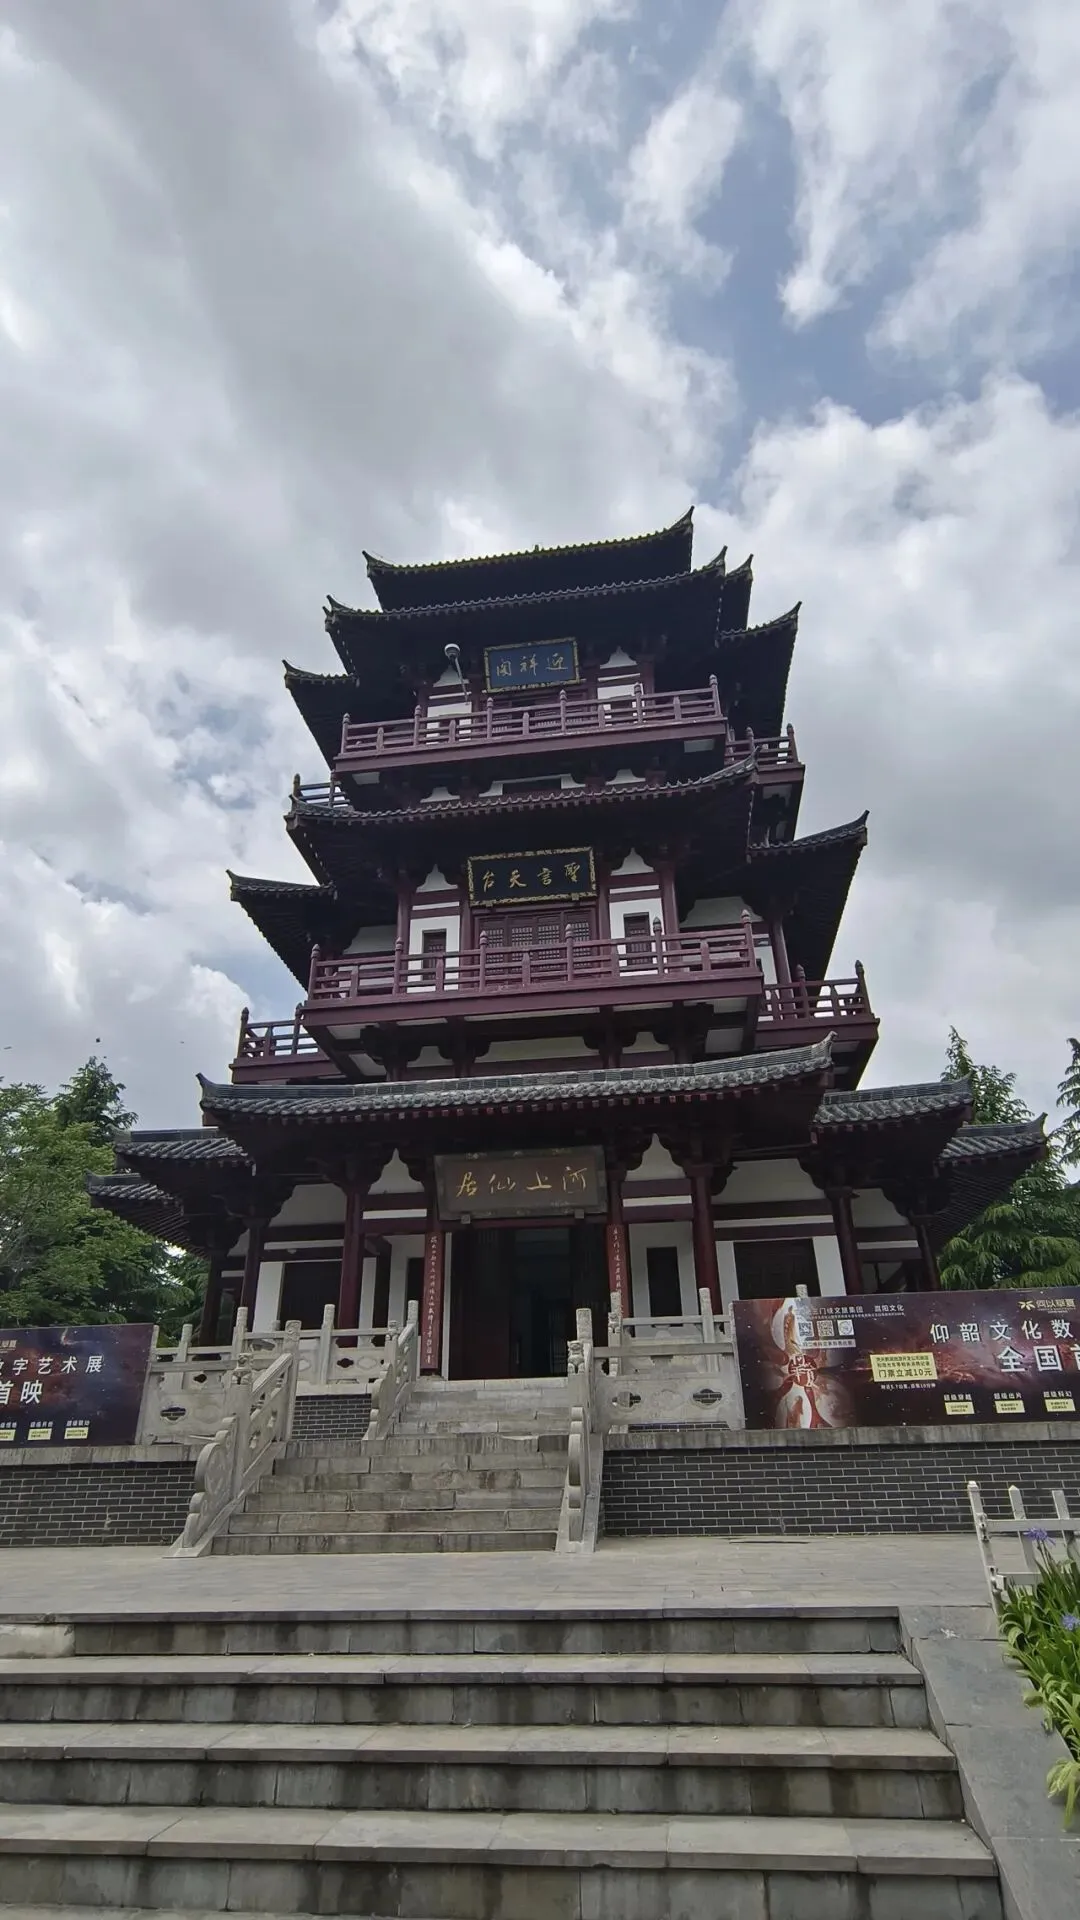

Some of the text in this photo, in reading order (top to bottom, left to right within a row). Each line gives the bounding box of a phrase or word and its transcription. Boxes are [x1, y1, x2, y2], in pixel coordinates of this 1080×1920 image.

[930, 1319, 1074, 1343] 仰韶文化数
[0, 1355, 103, 1376] 字艺术展
[879, 1367, 933, 1378] 门票立减10元
